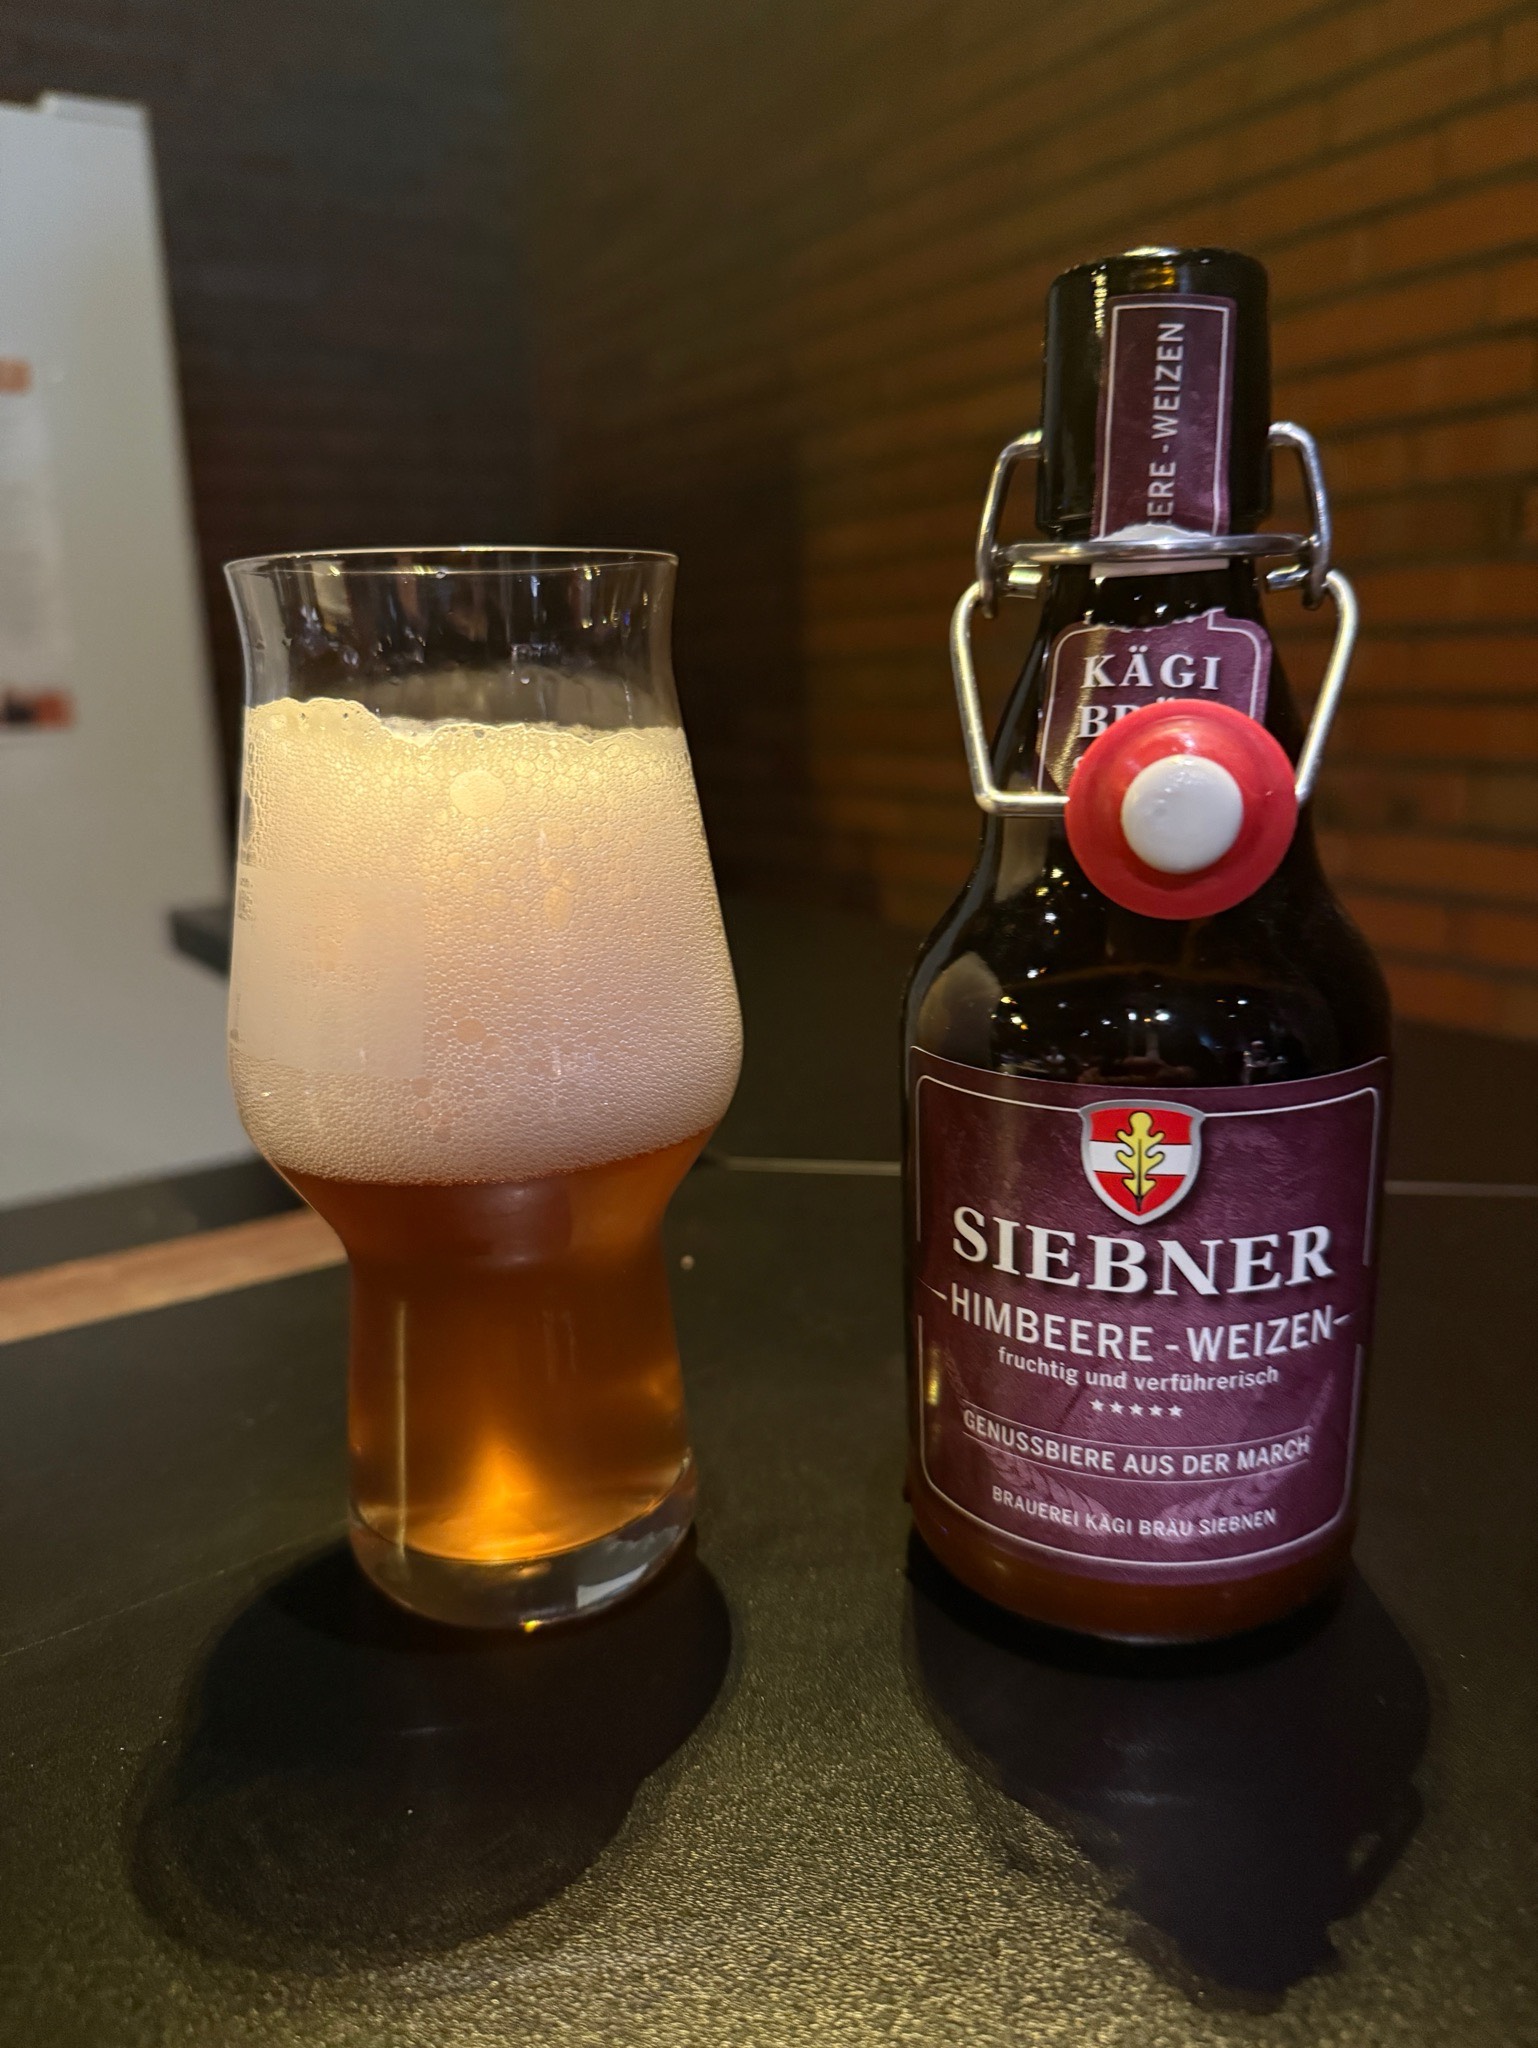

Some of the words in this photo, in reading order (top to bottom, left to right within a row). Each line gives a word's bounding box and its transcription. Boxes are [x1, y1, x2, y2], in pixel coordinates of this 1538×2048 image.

[1147, 461, 1176, 523] ERE
[1080, 645, 1221, 690] KÄGI
[953, 1206, 1335, 1295] SIEBNER
[951, 1282, 1153, 1362] HIMBEERE
[998, 1347, 1079, 1387] fruchtig
[1085, 1370, 1127, 1389] und
[1134, 1366, 1279, 1392] verführerisch
[963, 1410, 1115, 1471] GENUSSBIERE
[1123, 1453, 1174, 1475] AUS
[1182, 1453, 1230, 1474] DER
[1237, 1434, 1310, 1470] MARCH
[992, 1485, 1079, 1526] BRAUEREI
[1085, 1512, 1132, 1535] KÄGI
[1139, 1516, 1192, 1537] BRÄU
[1199, 1508, 1277, 1535] SIEBNEN
